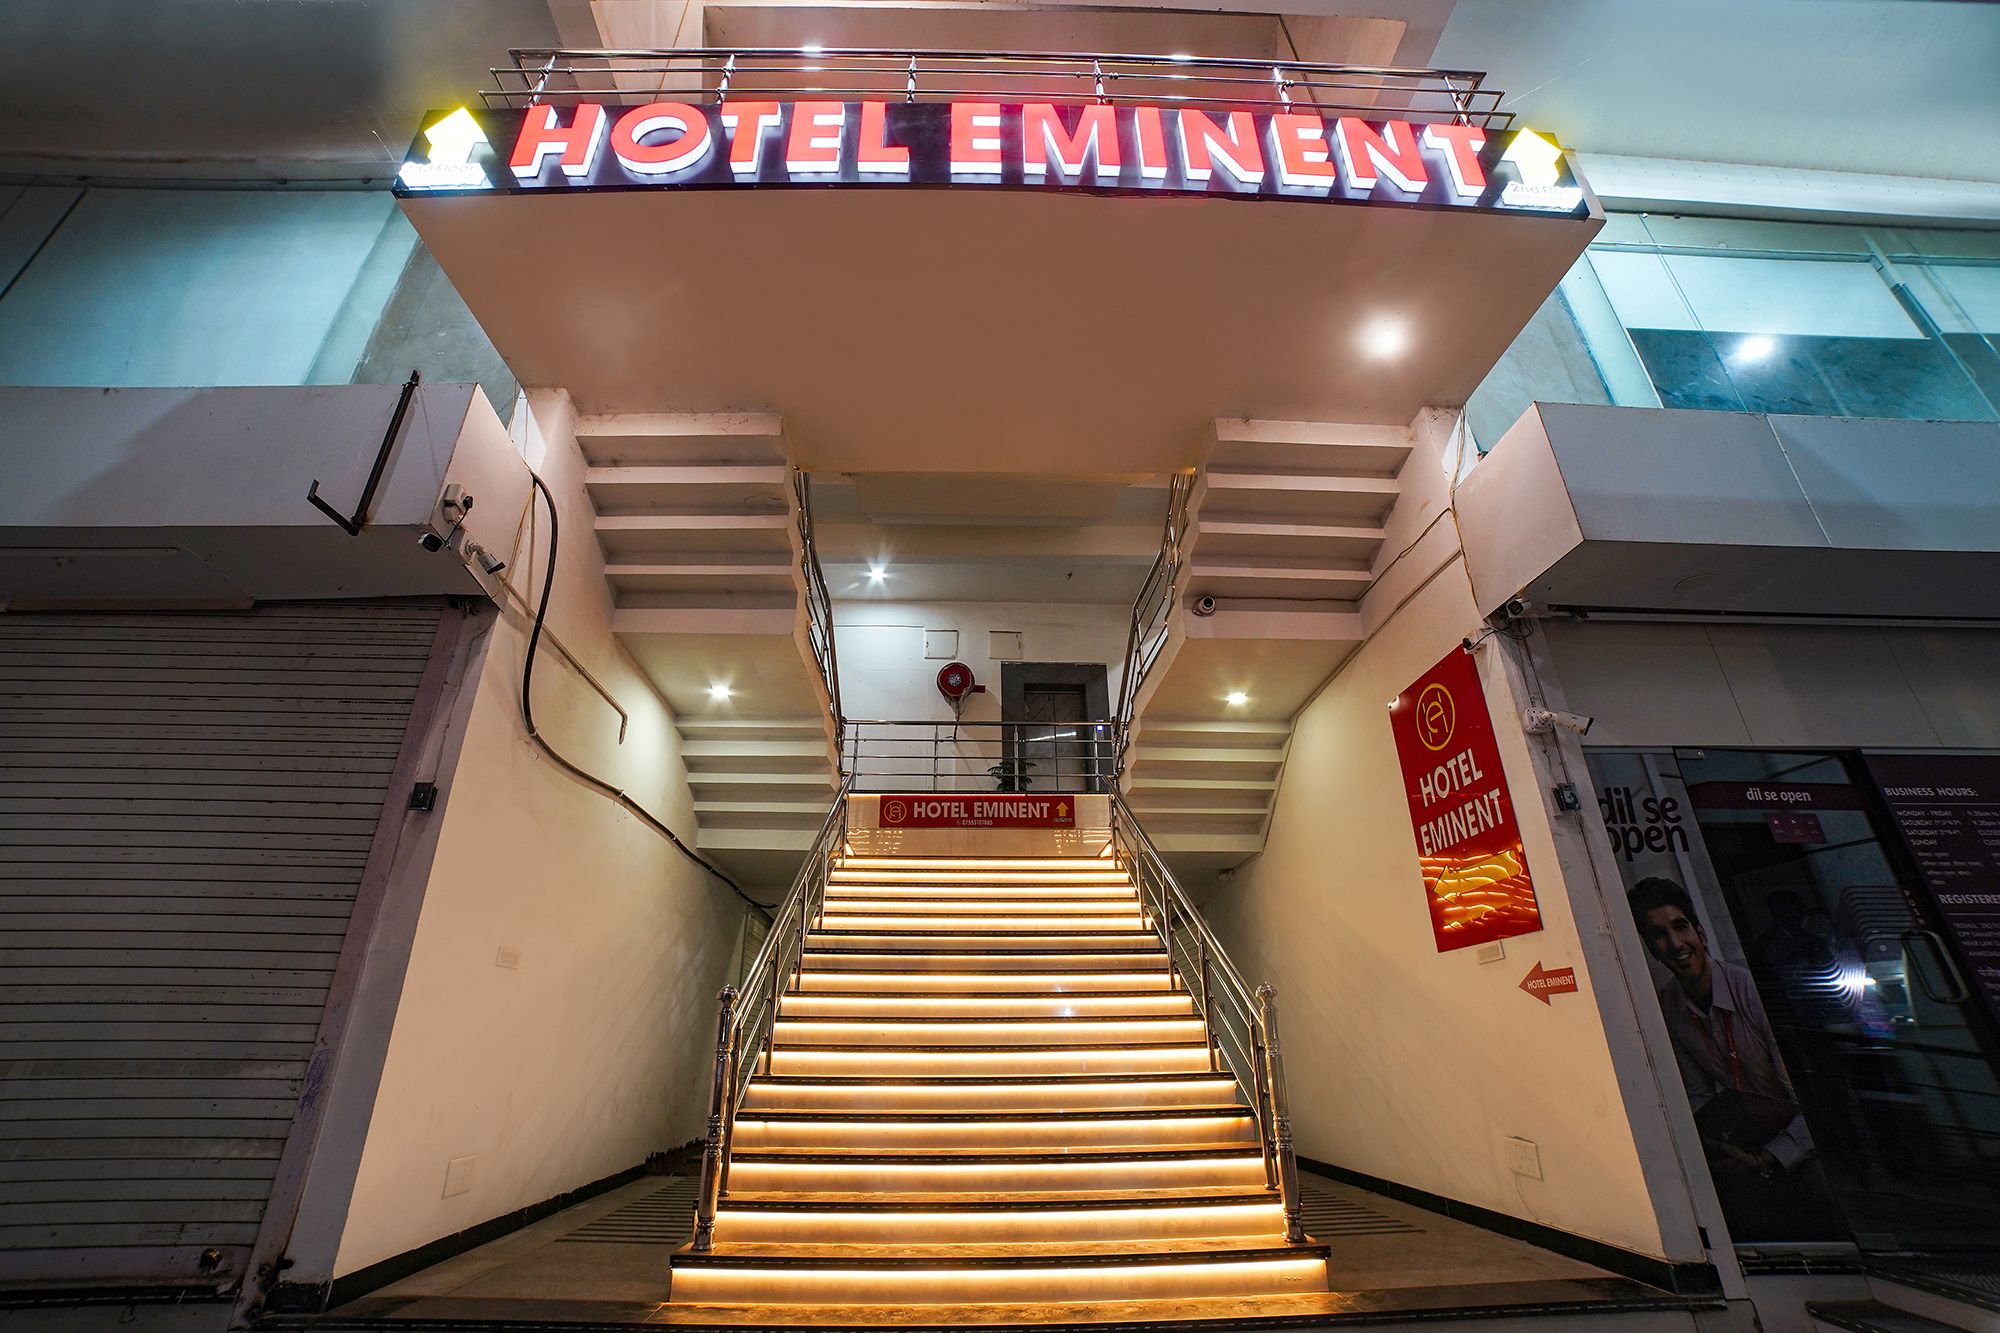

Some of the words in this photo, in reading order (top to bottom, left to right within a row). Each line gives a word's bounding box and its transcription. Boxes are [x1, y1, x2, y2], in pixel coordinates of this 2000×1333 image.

[510, 100, 910, 179] HOTEL
[950, 102, 1488, 197] EMINENT
[1419, 747, 1484, 808] HOTEL
[1746, 787, 1763, 801] dil
[1764, 791, 1778, 801] se
[1780, 791, 1812, 804] open
[1884, 787, 1935, 797] BUSINESS
[1936, 787, 1979, 797] HOURS:
[913, 801, 968, 818] HOTEL
[974, 801, 1050, 818] EMINENT
[1642, 797, 1682, 824] se
[1420, 787, 1505, 857] EMINENT
[1526, 978, 1547, 990] HOTEL
[1546, 975, 1575, 987] EMINENT
